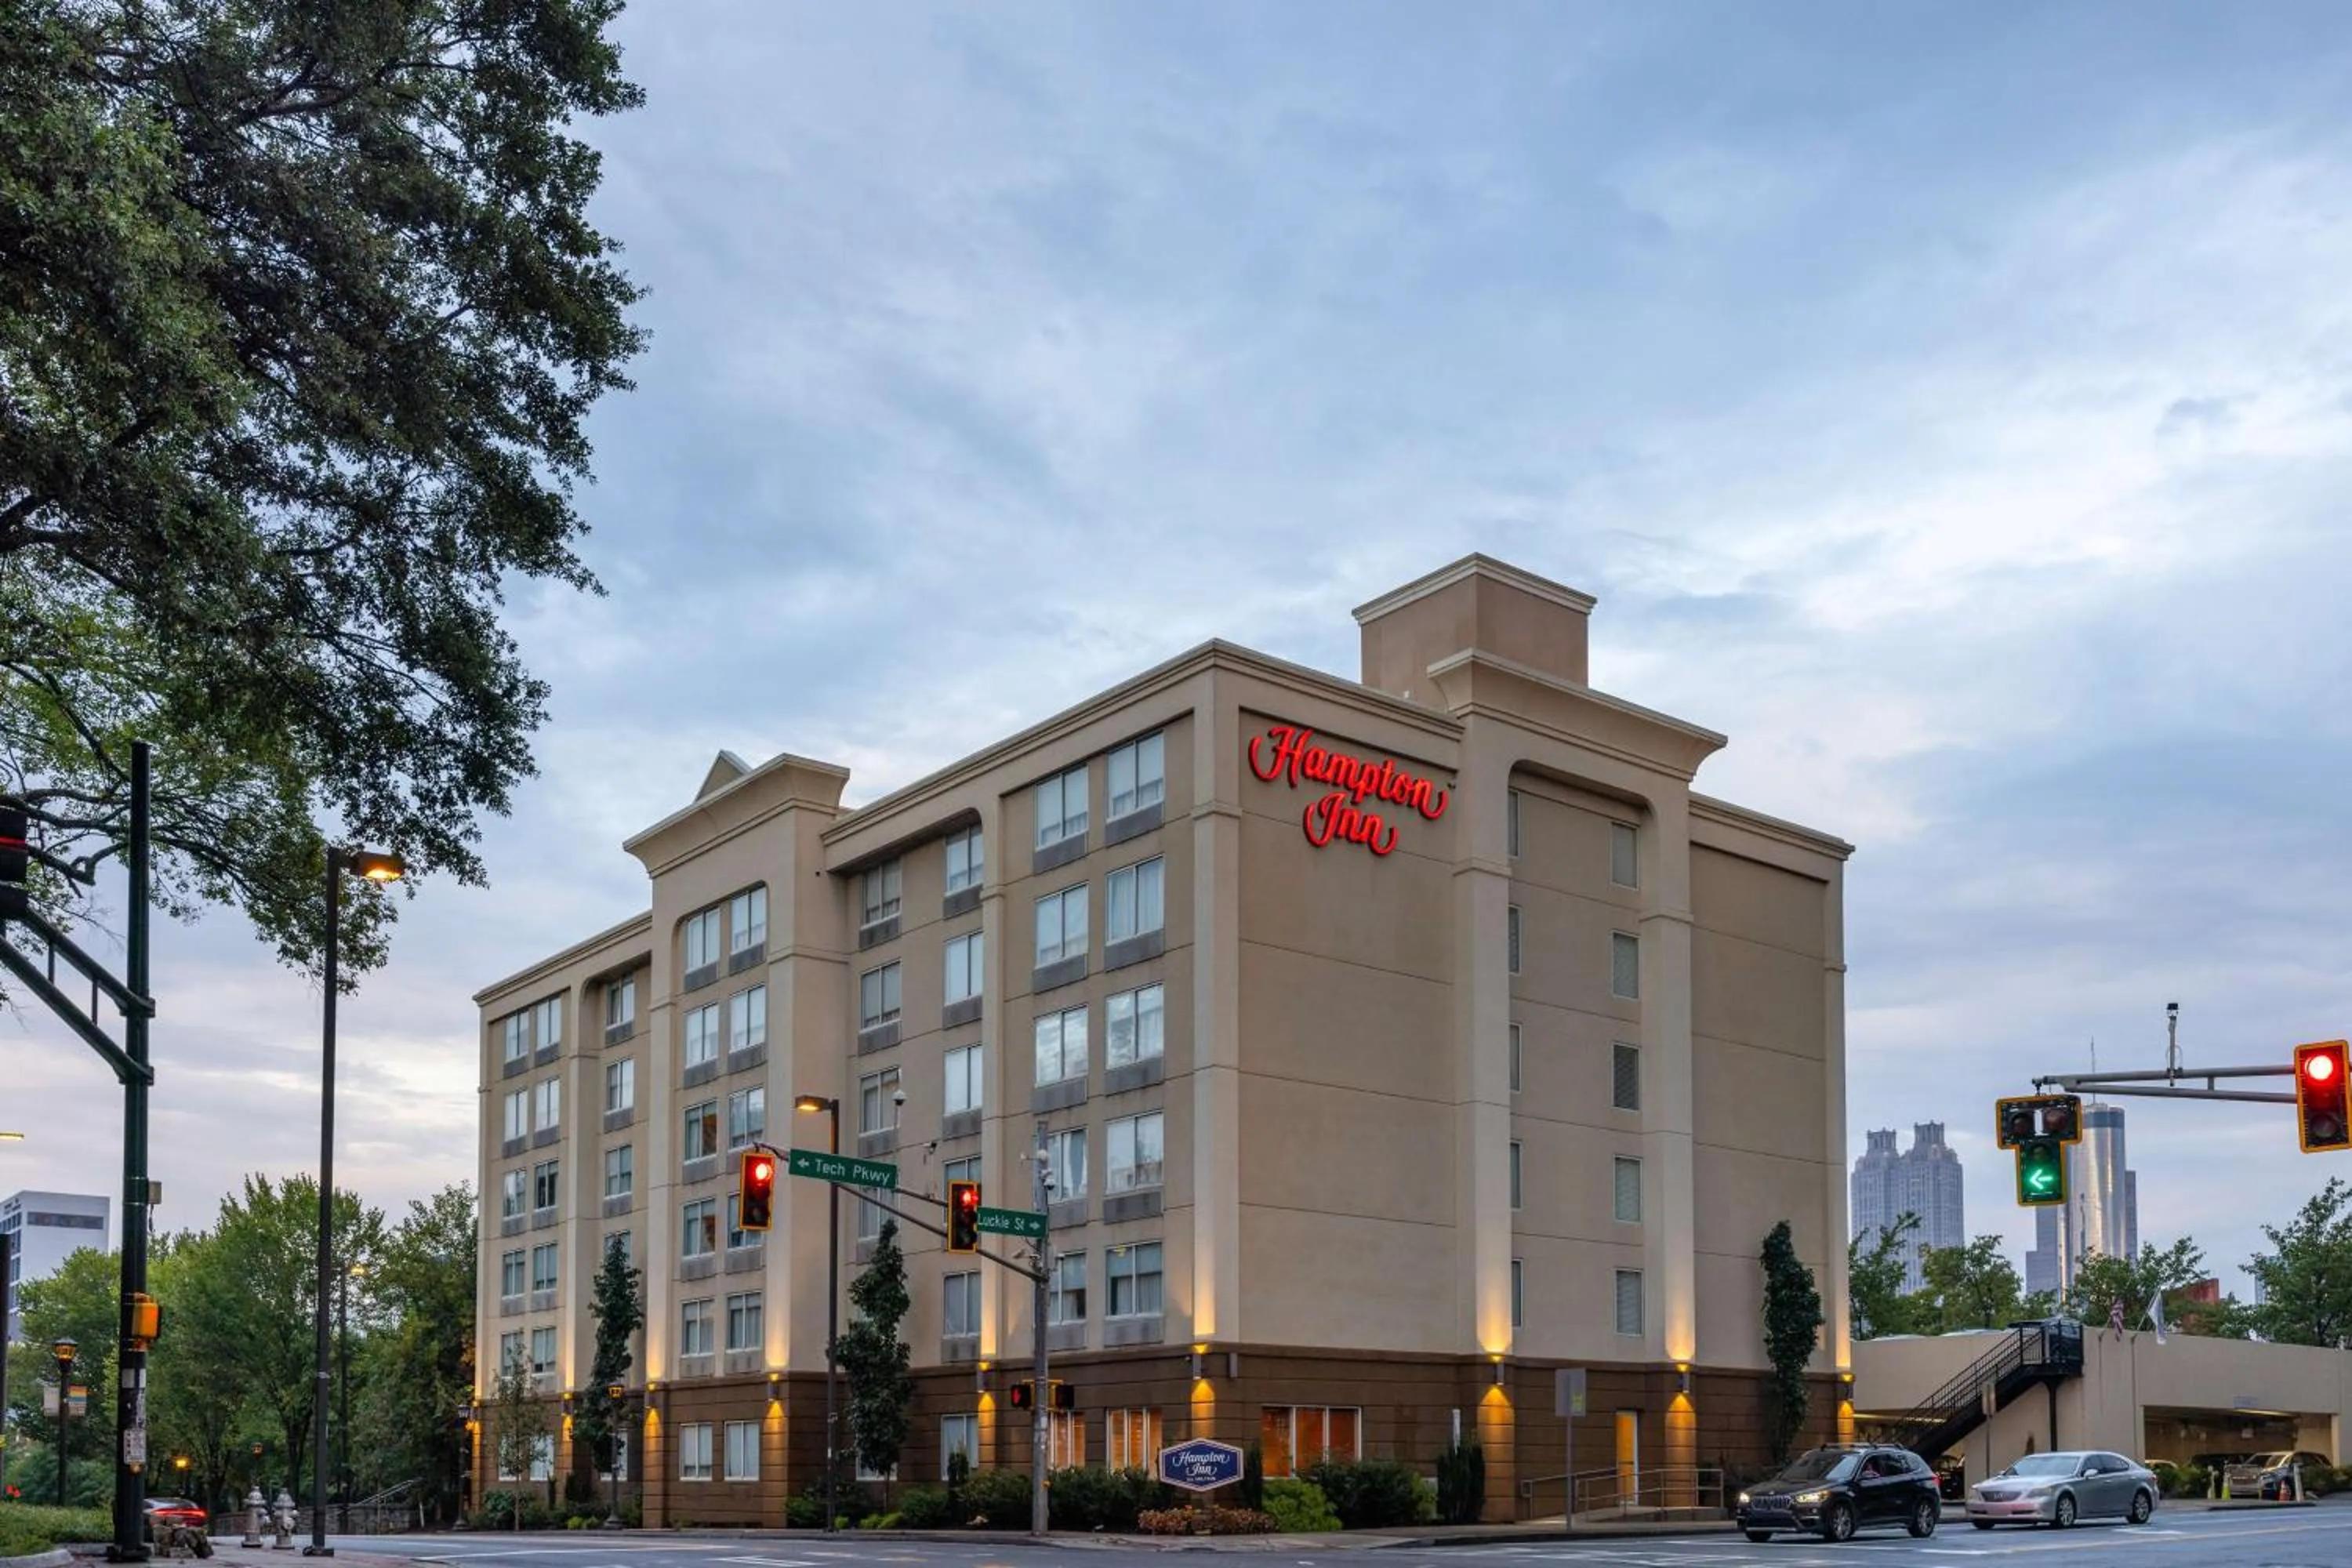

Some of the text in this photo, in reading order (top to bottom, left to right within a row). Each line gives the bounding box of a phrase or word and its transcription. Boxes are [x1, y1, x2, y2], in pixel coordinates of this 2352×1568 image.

[1248, 726, 1448, 820] Hampton
[1303, 791, 1399, 855] Inn
[815, 1159, 890, 1185] Tech Pkwy
[978, 1213, 1025, 1231] Luckie St
[1172, 1451, 1230, 1467] Hampton
[1185, 1463, 1218, 1476] Inn
